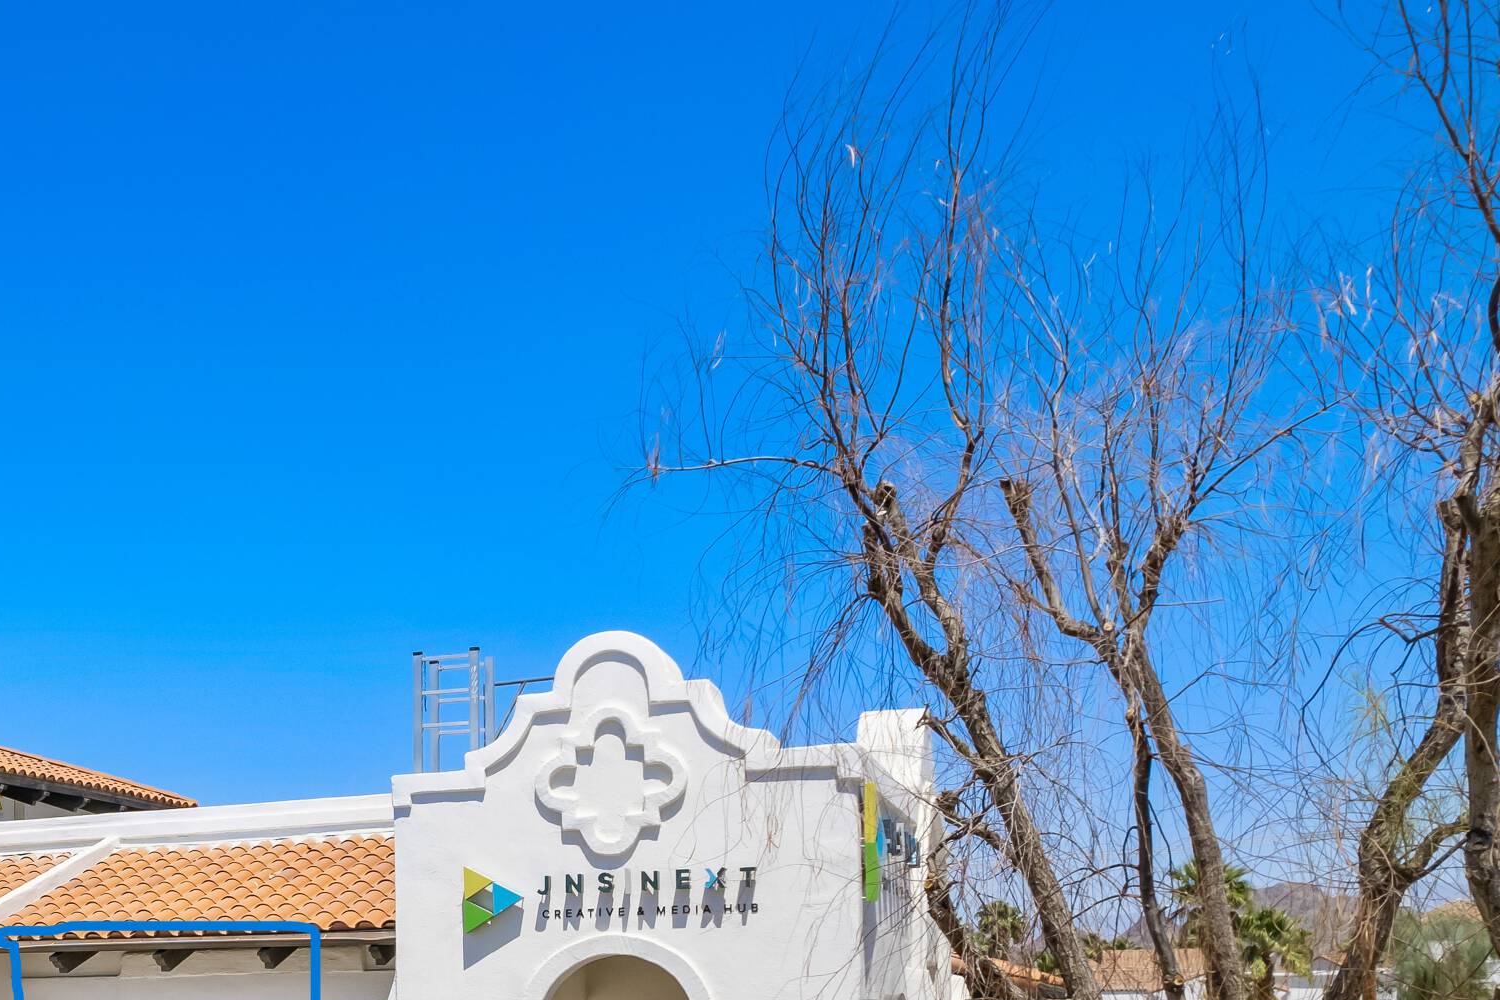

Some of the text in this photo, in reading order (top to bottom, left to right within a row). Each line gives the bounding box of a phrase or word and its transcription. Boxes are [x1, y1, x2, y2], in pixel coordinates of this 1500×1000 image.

[537, 866, 757, 896] JNS NEXT
[542, 902, 759, 920] CREATIVE & MEDIA HUB
